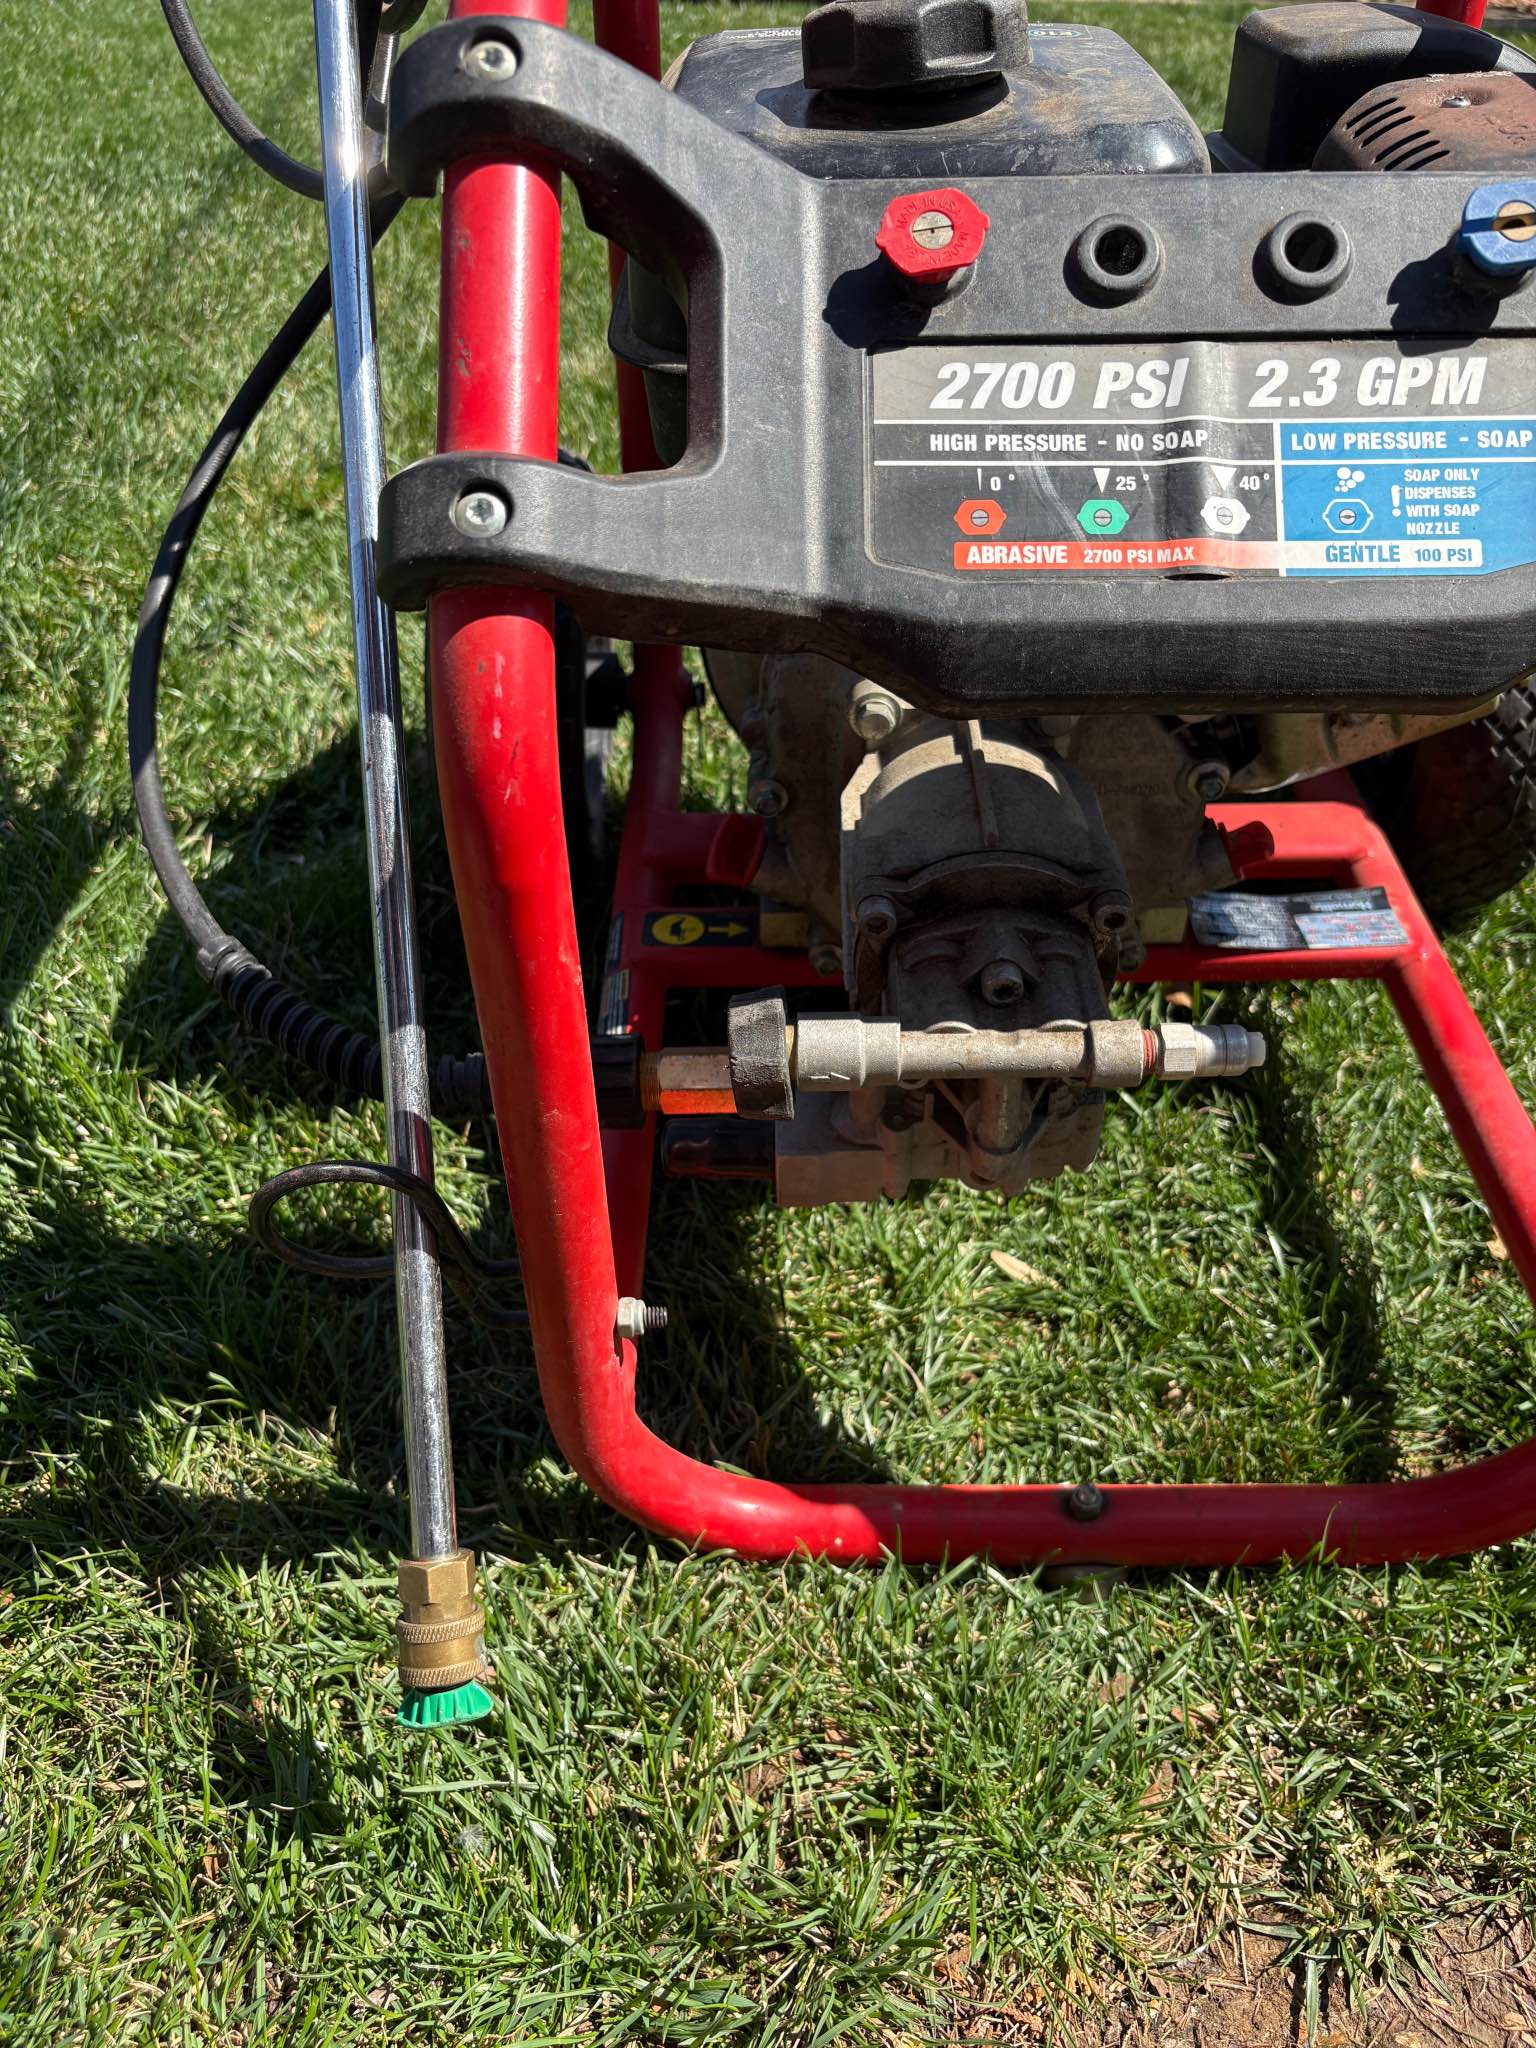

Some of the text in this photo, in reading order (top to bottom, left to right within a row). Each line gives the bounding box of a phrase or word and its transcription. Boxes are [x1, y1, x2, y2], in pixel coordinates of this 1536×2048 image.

[929, 357, 1190, 409] 2700 PSI
[1248, 356, 1488, 408] 2.3 GPM
[930, 433, 977, 451] HIGH
[985, 433, 1087, 451] PRESSURE
[1116, 433, 1144, 450] NO
[1152, 429, 1208, 449] SOAP
[1291, 432, 1336, 451] LOW
[1344, 431, 1447, 450] PRESSURE
[1477, 430, 1533, 449] SOAP
[1404, 468, 1480, 481] SOAP ONLY
[1404, 486, 1477, 499] DISPENSES
[1406, 504, 1480, 517] WITH SOAP
[1406, 522, 1460, 535] NOZZLE
[967, 545, 1195, 564] ABRASIVE 2700 PSI MAX
[1325, 544, 1472, 562] GENTLE 100 PSI
